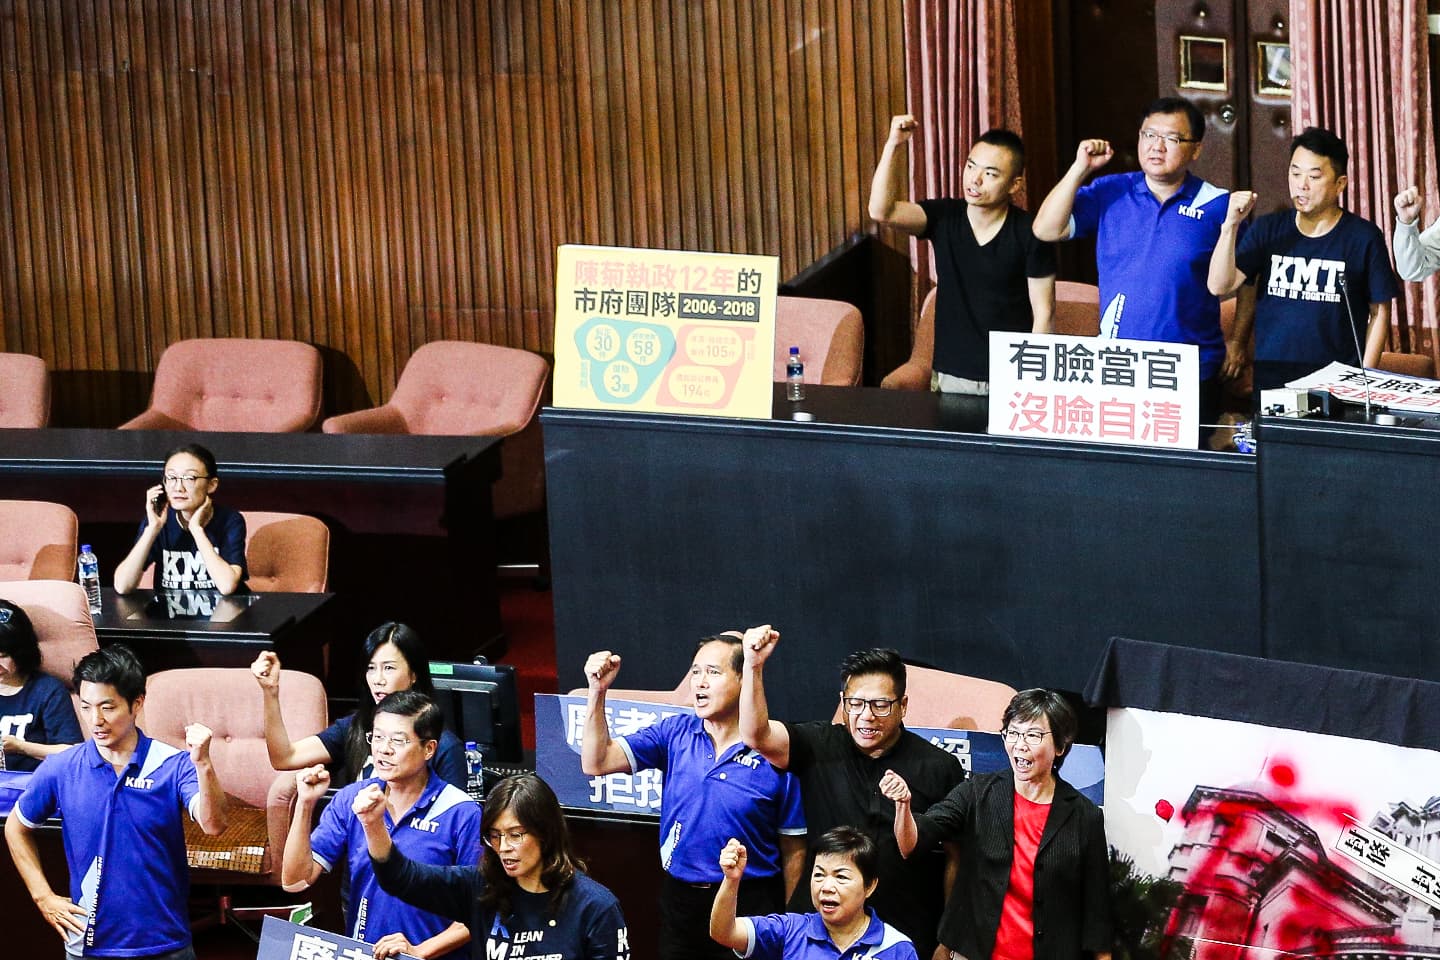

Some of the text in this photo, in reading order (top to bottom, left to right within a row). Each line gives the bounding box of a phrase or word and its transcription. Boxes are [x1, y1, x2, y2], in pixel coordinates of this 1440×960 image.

[1178, 204, 1204, 220] KMT
[574, 260, 762, 294] 陳菊執政12年的
[1268, 255, 1346, 294] KMT
[574, 288, 755, 317] 市府團隊 2006-2018
[594, 336, 613, 352] 30
[634, 340, 653, 356] 58
[1009, 340, 1181, 391] 有臉當官
[1008, 391, 1182, 444] 沒臉自清
[163, 549, 211, 581] KM
[733, 753, 761, 770] KMT
[124, 776, 154, 789] KMT
[410, 817, 440, 833] KMT
[514, 931, 543, 944] LEAN
[510, 945, 525, 957] IN
